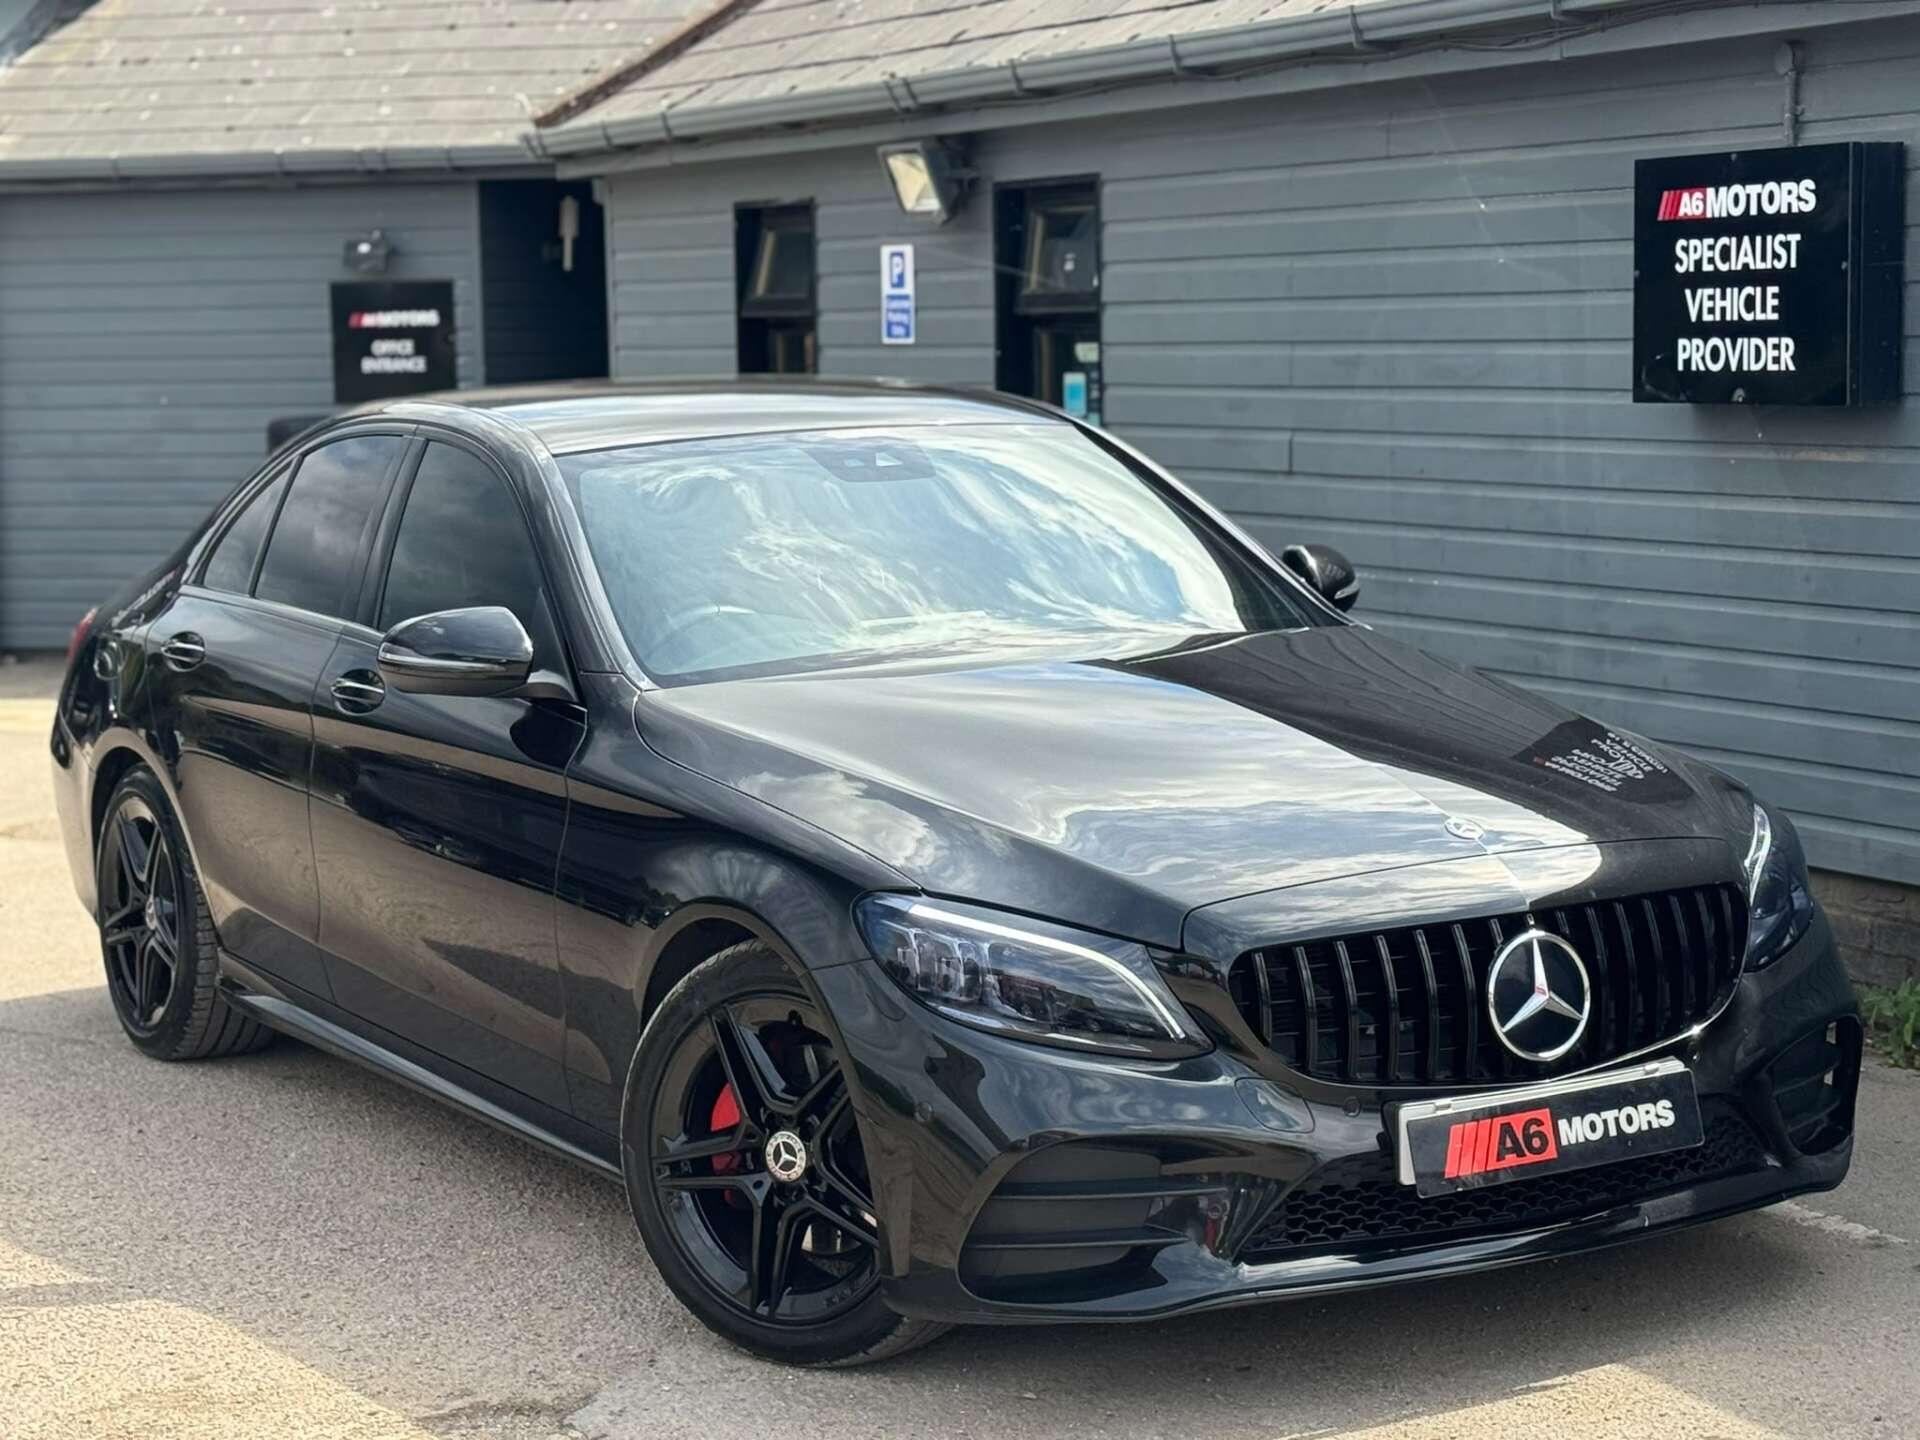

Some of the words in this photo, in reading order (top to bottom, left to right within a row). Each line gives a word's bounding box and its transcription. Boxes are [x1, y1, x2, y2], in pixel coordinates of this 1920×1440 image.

[892, 255, 903, 284] P
[1674, 234, 1801, 273] SPECIALIST
[1685, 286, 1779, 322] VEHICLE
[1677, 337, 1796, 371] PROVIDER
[1495, 1117, 1549, 1162] A6
[1558, 1099, 1676, 1146] MOTORS
